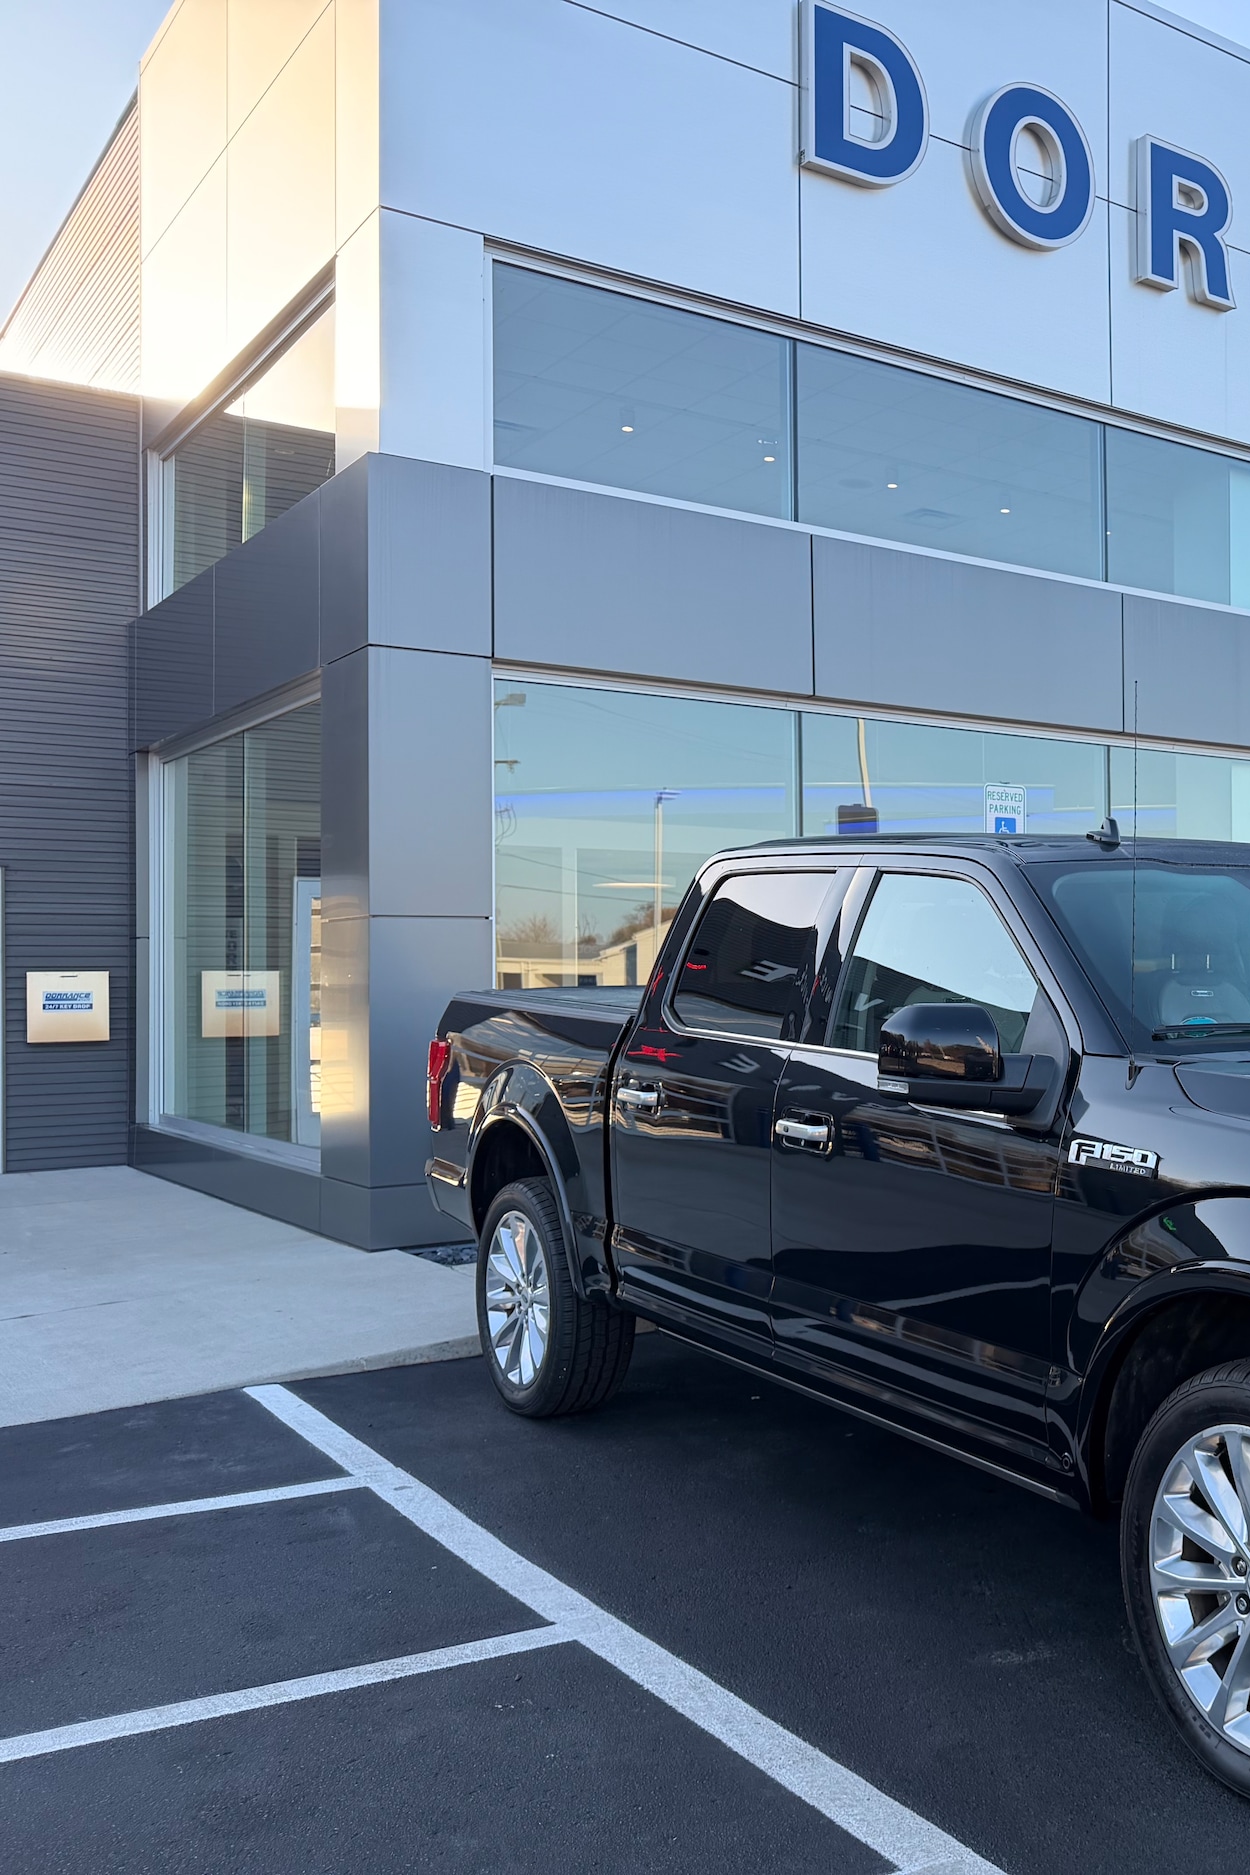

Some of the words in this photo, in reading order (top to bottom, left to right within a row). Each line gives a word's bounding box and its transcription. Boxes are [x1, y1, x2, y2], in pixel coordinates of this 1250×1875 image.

[987, 790, 1023, 803] RESERVED
[989, 803, 1022, 816] PARKING
[1110, 1162, 1147, 1176] LIMITED
